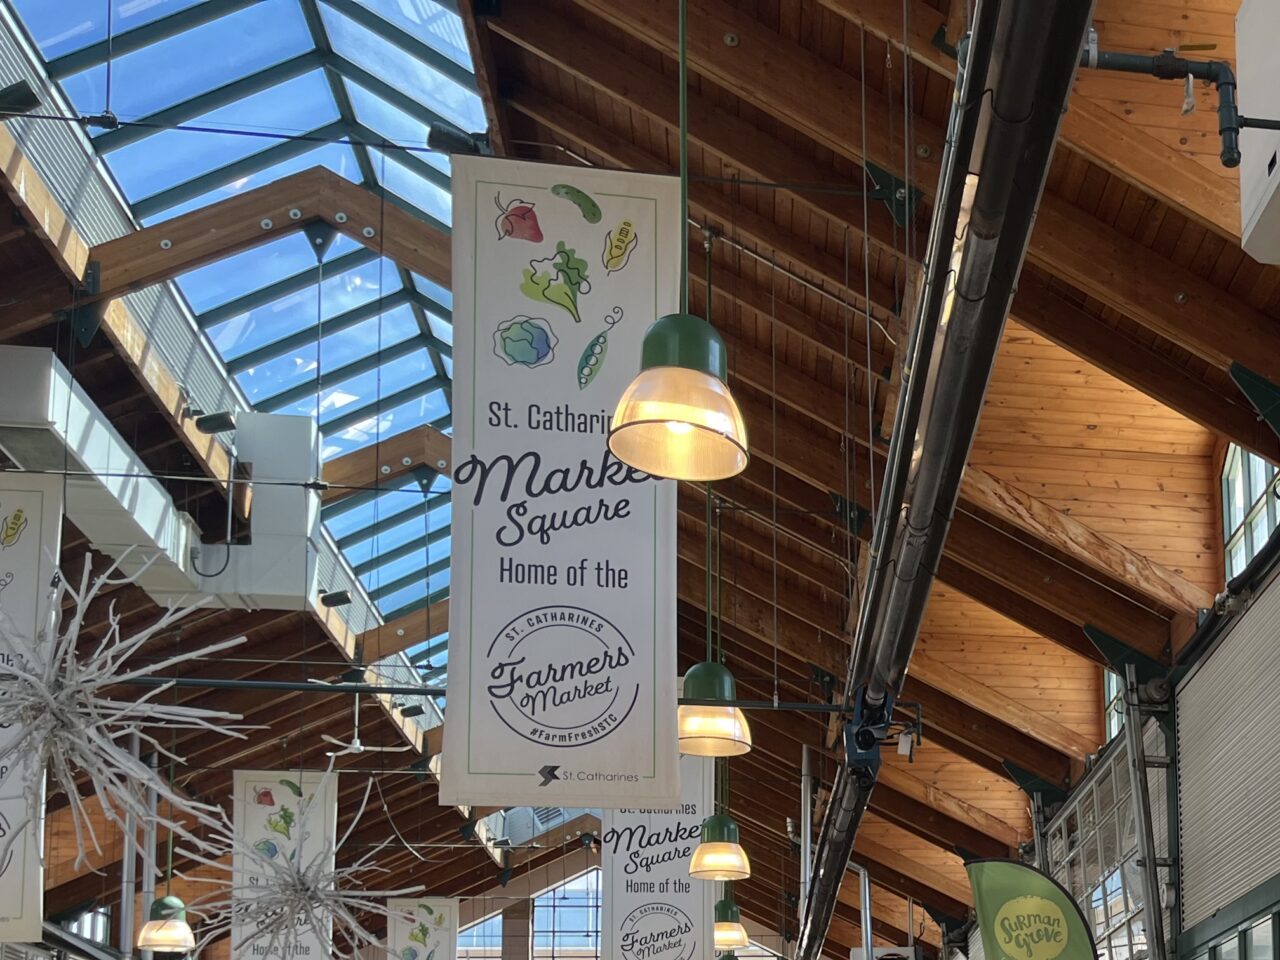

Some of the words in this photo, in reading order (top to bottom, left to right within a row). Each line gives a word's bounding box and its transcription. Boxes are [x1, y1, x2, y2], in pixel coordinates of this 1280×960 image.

[489, 402, 518, 430] St.
[528, 404, 614, 434] Cathari
[454, 452, 665, 506] Marke
[496, 498, 631, 547] Square
[500, 557, 557, 586] Home
[566, 559, 588, 587] of
[595, 559, 628, 589] the
[505, 627, 524, 641] ST.
[527, 612, 604, 633] CATHARINES
[488, 646, 629, 698] Farmers
[520, 676, 612, 716] Market
[530, 713, 618, 742] #FarmFreshSTC
[562, 770, 576, 781] St.
[577, 770, 639, 783] Catharines
[603, 819, 706, 854] Marke
[624, 846, 691, 874] Square
[626, 879, 655, 893] Home
[659, 878, 670, 893] of
[674, 879, 690, 893] the
[621, 923, 691, 951] Farmers
[636, 938, 682, 960] Market
